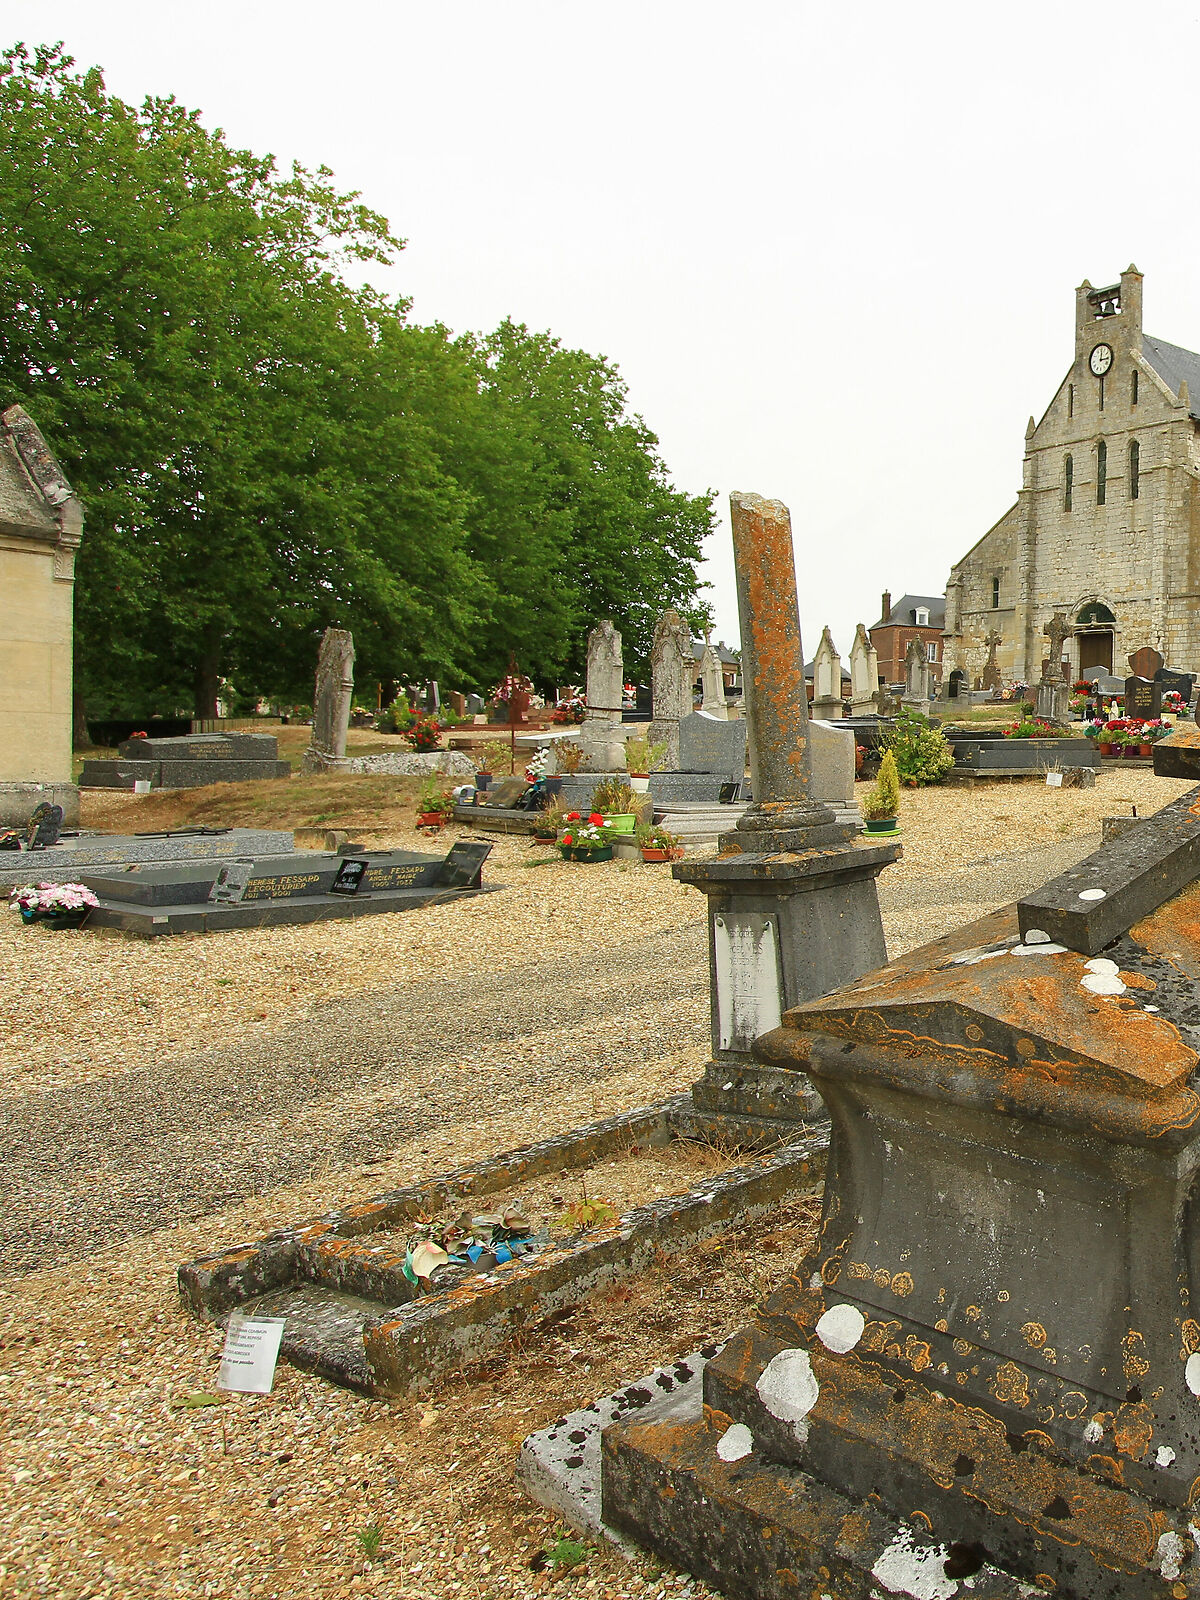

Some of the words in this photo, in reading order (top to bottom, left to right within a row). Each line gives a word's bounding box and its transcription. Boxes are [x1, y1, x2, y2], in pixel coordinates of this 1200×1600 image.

[390, 866, 425, 874] FESSARD
[280, 874, 320, 884] FESSARD
[248, 882, 307, 893] LECOUTURIER
